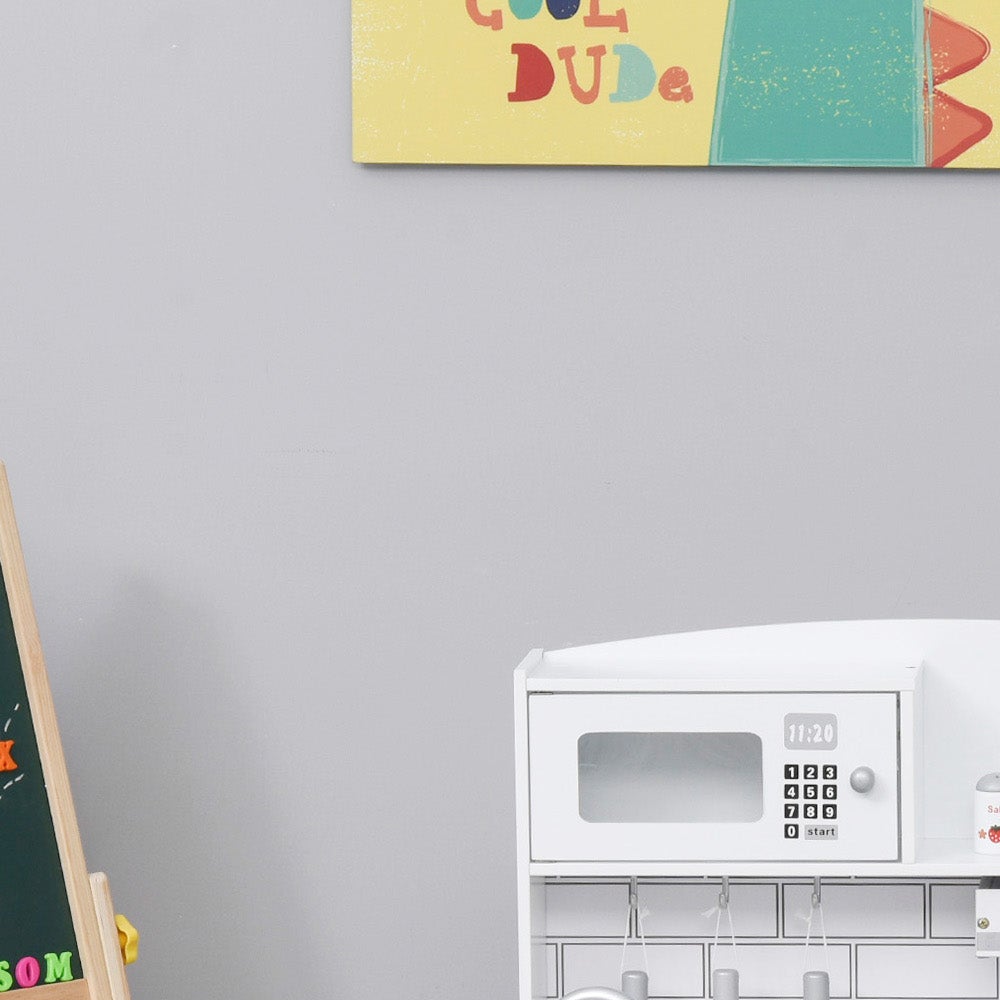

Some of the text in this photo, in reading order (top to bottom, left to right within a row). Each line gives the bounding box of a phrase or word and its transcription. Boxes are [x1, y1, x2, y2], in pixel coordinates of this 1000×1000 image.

[788, 723, 835, 743] 11:20
[788, 766, 834, 779] 1 2 3
[787, 786, 834, 798] 4 5 6
[787, 806, 834, 818] 7 8 9
[787, 826, 835, 837] 0 start
